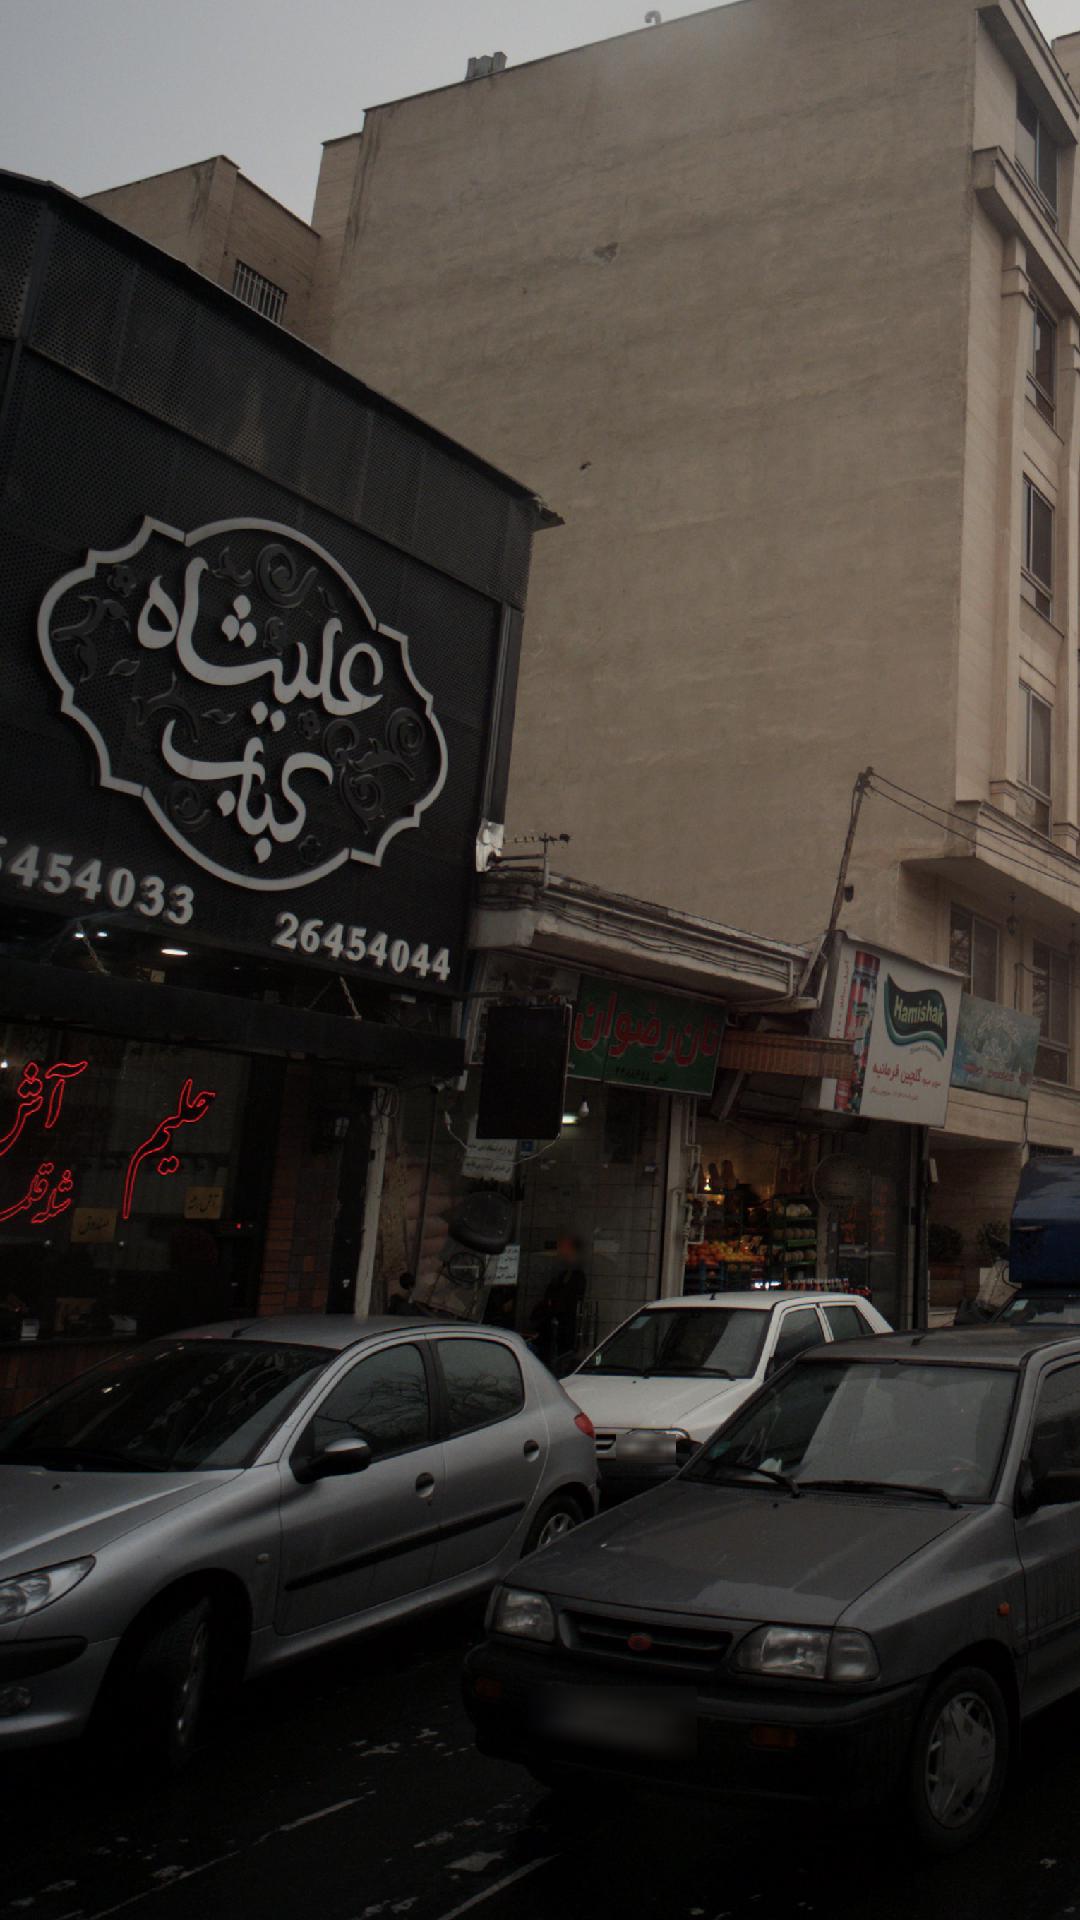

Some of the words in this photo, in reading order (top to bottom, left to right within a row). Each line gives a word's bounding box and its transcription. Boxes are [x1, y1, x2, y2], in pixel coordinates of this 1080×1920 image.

[137, 556, 384, 732] علیشاه
[161, 719, 334, 864] کباب
[0, 835, 195, 925] 454033
[272, 911, 452, 984] 26454044
[574, 991, 674, 1064] رضوان
[893, 994, 945, 1029] Hamishak
